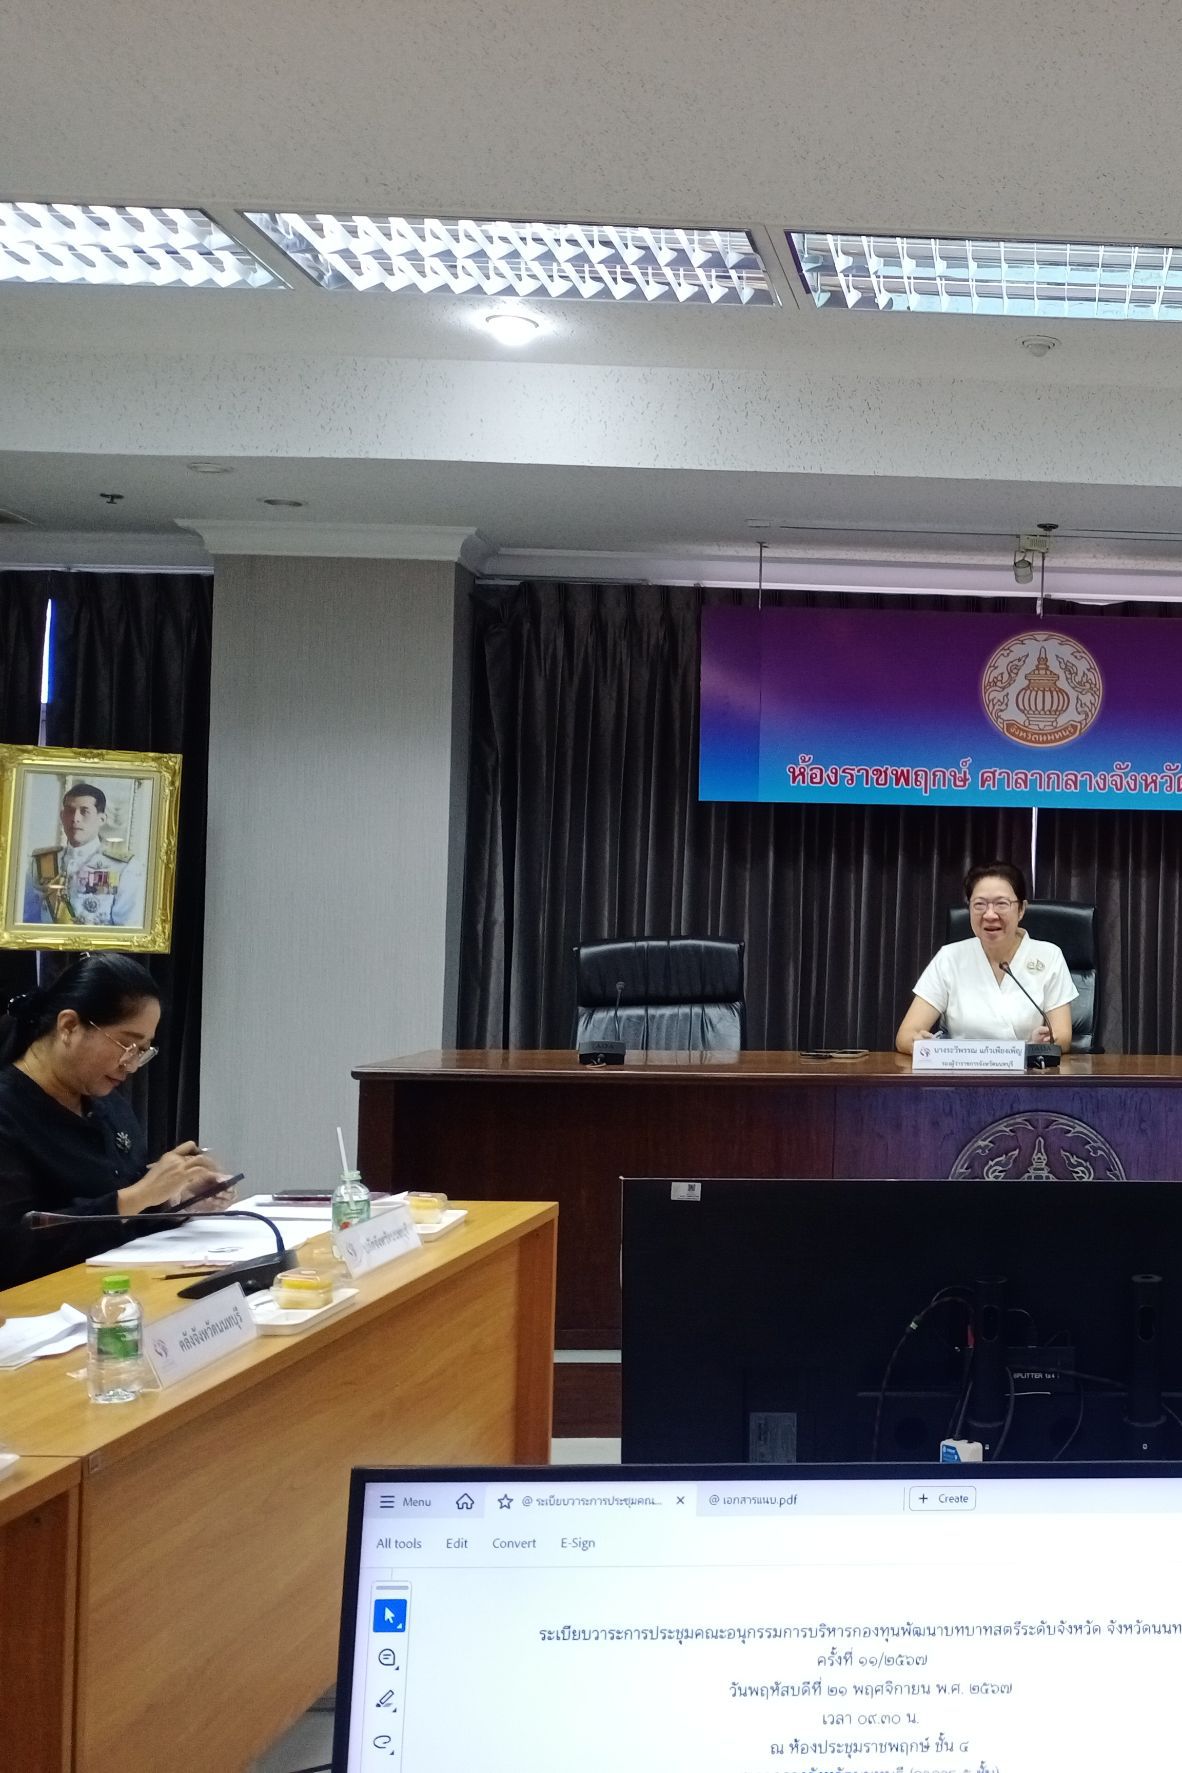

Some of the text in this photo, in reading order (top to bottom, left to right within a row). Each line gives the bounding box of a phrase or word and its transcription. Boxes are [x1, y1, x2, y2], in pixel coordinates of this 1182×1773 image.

[787, 754, 973, 796] ห้องราชพฤกษ์
[178, 1305, 244, 1353] คลังจังหวัดนนทบุรี
[402, 1496, 432, 1508] Menu
[723, 1494, 798, 1508] เอกสารแนบ.pdf
[938, 1493, 969, 1504] Create
[376, 1538, 422, 1549] All tools
[446, 1538, 468, 1549] Edit
[492, 1538, 537, 1549] Convert
[561, 1537, 596, 1552] E-Sign
[539, 1620, 1101, 1645] ระเบียบวาระการประชุมคณะอนุกรรมการบริหารกองทุนพัฒนาบทบาทสตรีระดับจังหวัด
[817, 1646, 928, 1669] ครั้งที่ ๑๑/๒๕๖๗
[729, 1677, 1012, 1700] วันพฤหัสบดีที่ ๒๑ พฤศจิกายน พ.ศ. ๒๕๖๗
[822, 1711, 920, 1725] เวลา ๐๙.๓๐ น.
[770, 1742, 784, 1755] ณ
[789, 1737, 930, 1759] ห้องประชุมราชพฤกษ์
[935, 1732, 954, 1752] ชั้น
